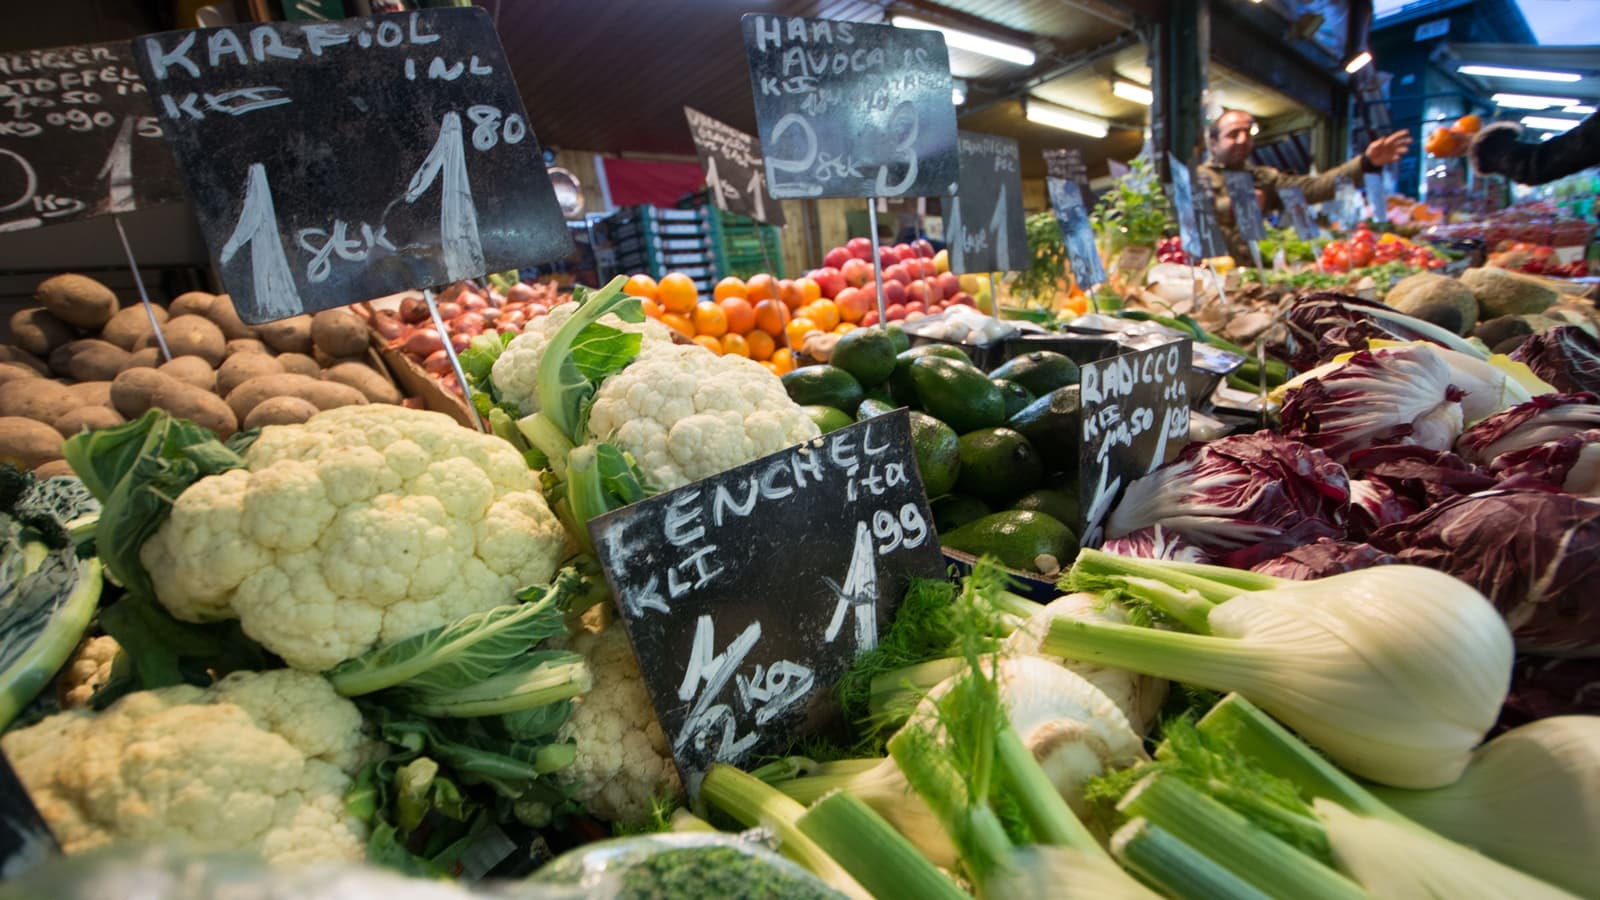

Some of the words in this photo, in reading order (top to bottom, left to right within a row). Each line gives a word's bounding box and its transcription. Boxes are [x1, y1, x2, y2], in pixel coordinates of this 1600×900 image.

[405, 55, 493, 80] INL
[754, 15, 855, 53] HAAS
[764, 112, 824, 200] 2
[873, 100, 919, 197] 3
[219, 162, 304, 317] 1
[1080, 344, 1180, 408] RADICCO
[601, 423, 892, 577] FENCHEL
